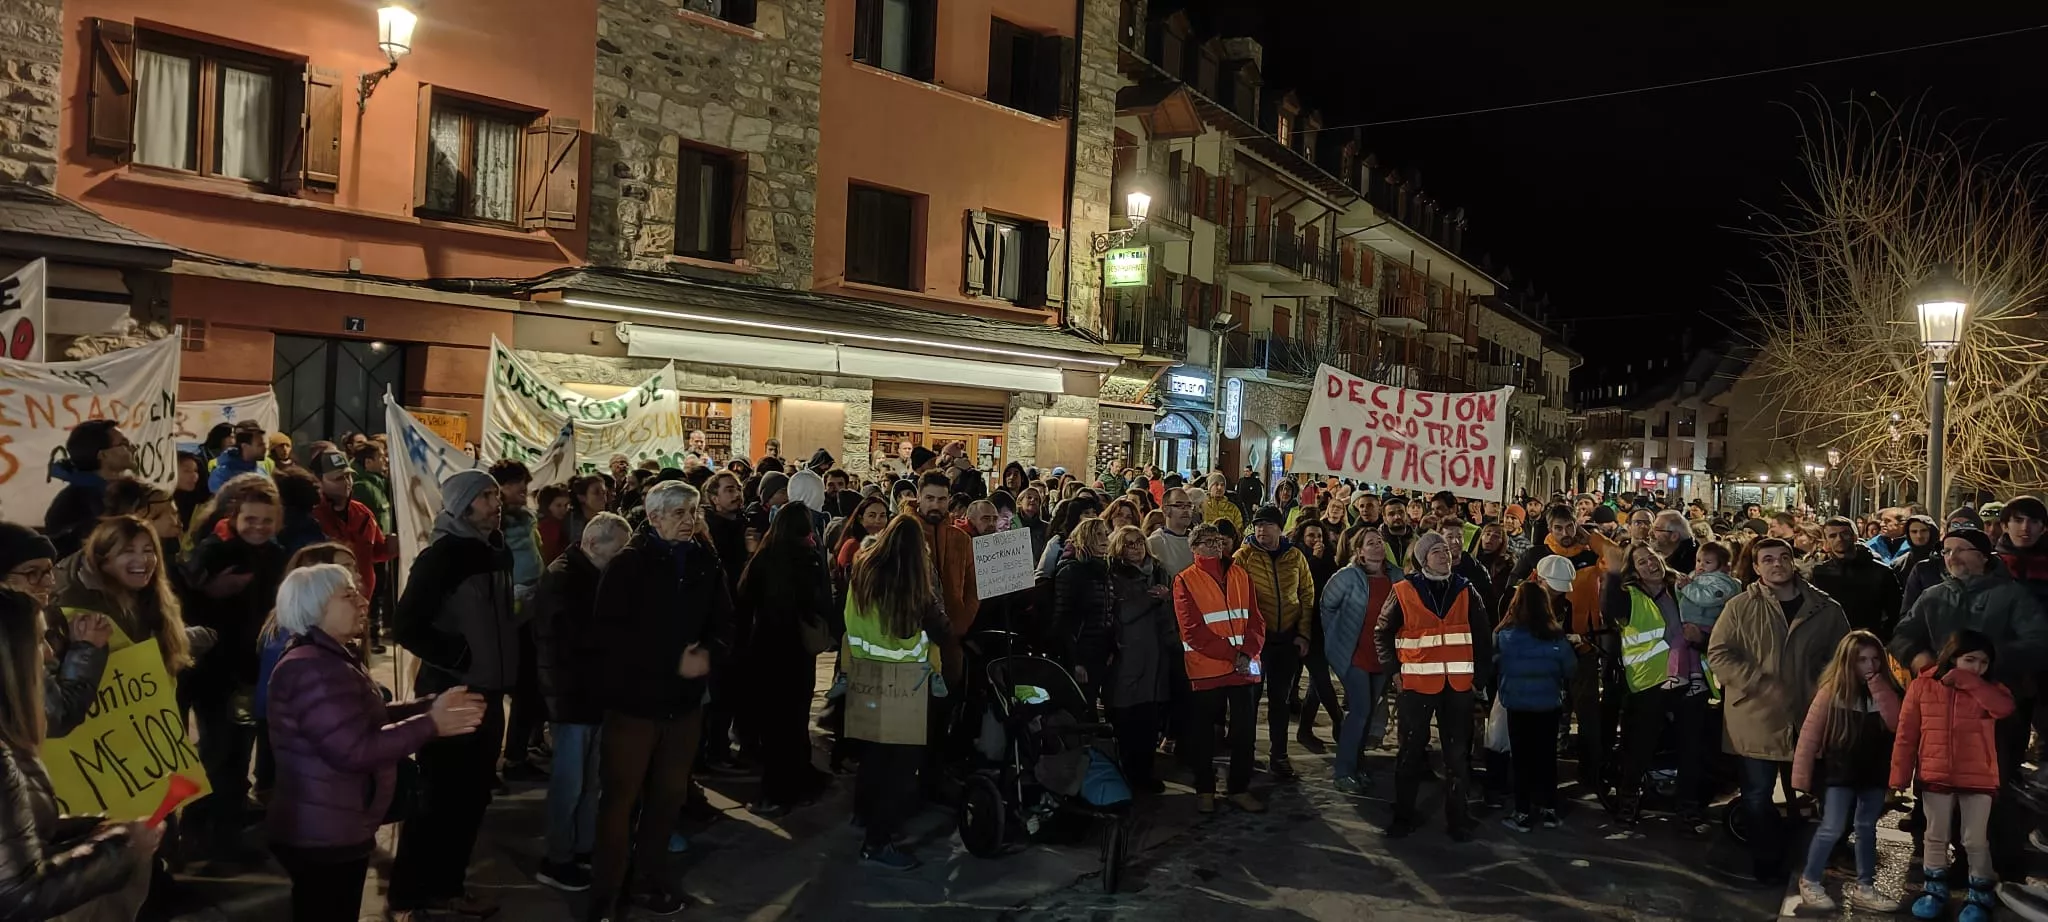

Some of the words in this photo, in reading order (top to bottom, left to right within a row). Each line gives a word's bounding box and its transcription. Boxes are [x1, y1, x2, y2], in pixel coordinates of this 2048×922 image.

[1119, 251, 1147, 259] PIERIA
[0, 316, 35, 361] O
[352, 319, 359, 330] 7
[640, 376, 663, 407] DE
[1328, 374, 1496, 422] DECISIÓN
[1230, 394, 1238, 433] SNOW
[1365, 410, 1419, 438] SOLO
[1423, 420, 1489, 451] TRAS
[1319, 426, 1496, 491] VOTACIÓN
[975, 538, 990, 550] MIS
